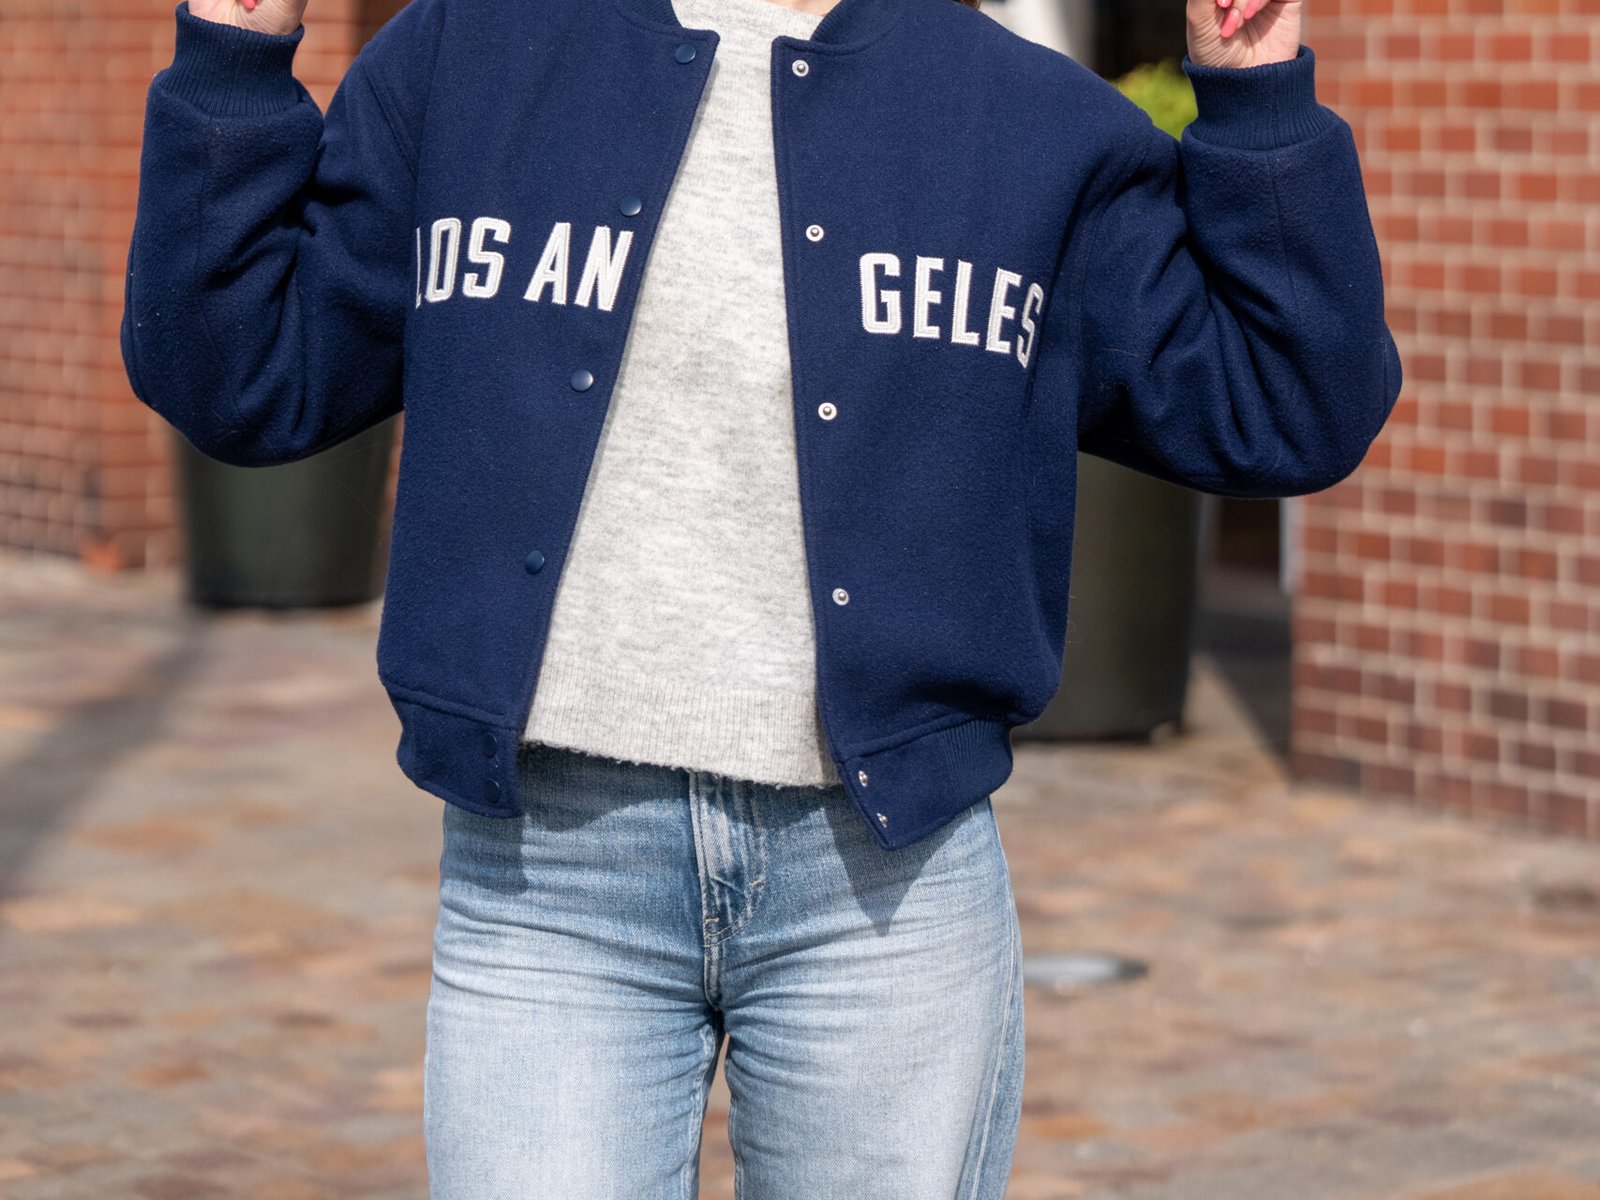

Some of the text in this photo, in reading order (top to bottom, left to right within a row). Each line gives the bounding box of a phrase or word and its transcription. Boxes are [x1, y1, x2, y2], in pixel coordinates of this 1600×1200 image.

[415, 217, 1044, 368] OS AN GELES
